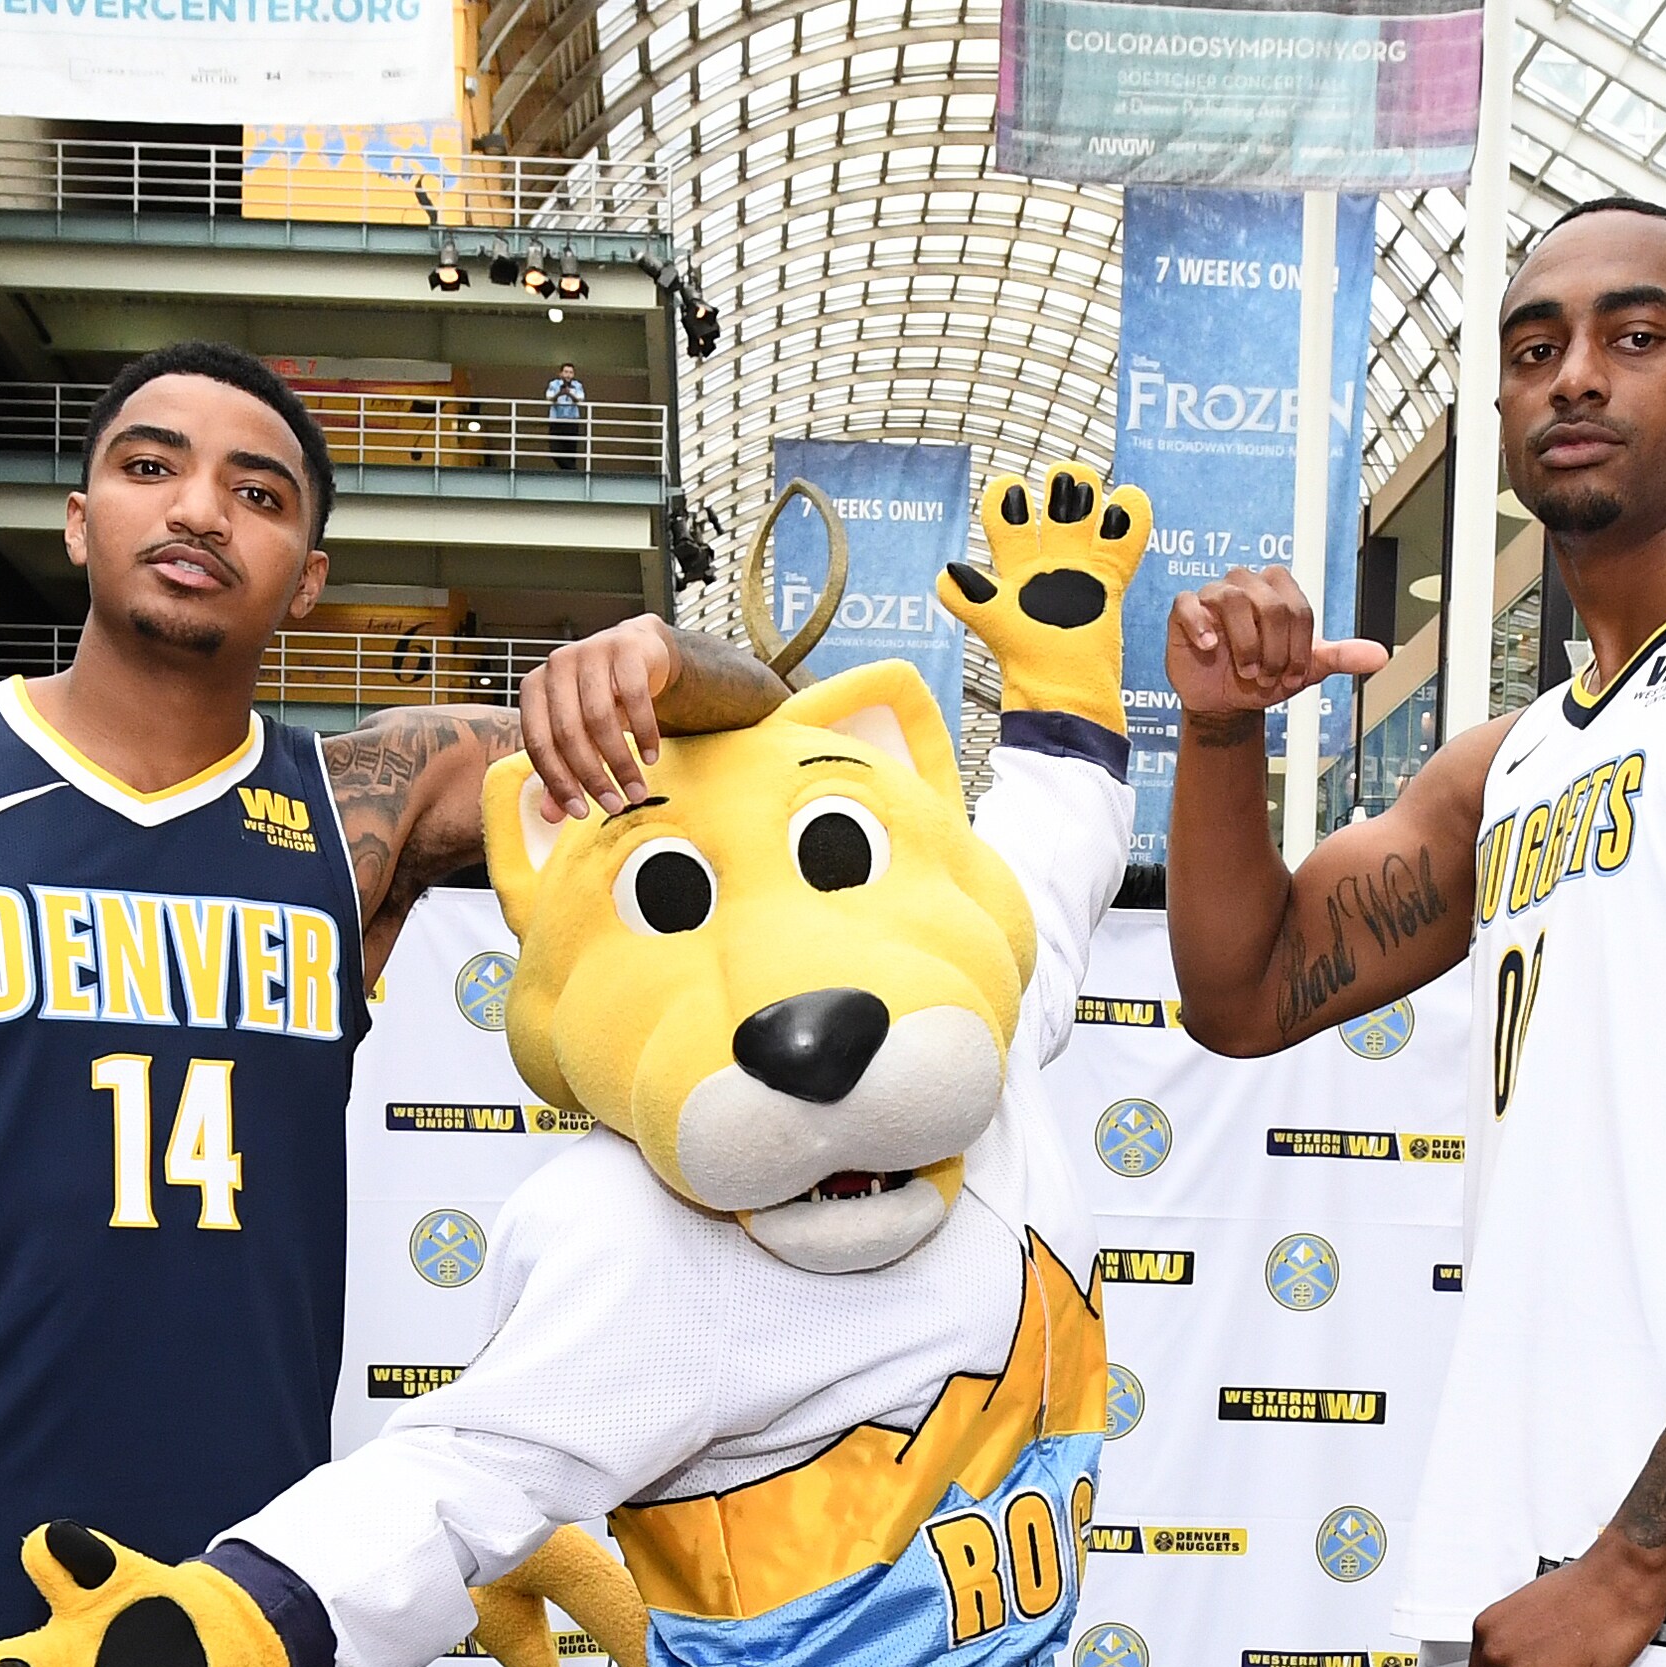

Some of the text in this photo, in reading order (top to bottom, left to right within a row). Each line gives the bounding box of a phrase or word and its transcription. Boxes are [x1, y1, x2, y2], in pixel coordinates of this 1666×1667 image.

[1065, 30, 1406, 62] COLORADOSYMPHONY.ORG
[1156, 256, 1170, 283] 7
[1178, 258, 1261, 288] WEEKS
[833, 498, 883, 520] EEKS
[889, 500, 944, 522] ONLY!
[1145, 530, 1194, 555] AUG
[1205, 531, 1231, 556] 17
[1259, 534, 1294, 560] OC
[1167, 560, 1220, 577] BUELL
[391, 620, 436, 684] 6
[237, 786, 310, 831] WU
[243, 819, 314, 843] WESTERN
[267, 832, 316, 854] UNION
[1112, 1002, 1154, 1025] WU
[393, 1107, 515, 1130] WESTERN WU
[415, 1118, 465, 1129] UNION
[92, 1053, 242, 1230] 14
[1273, 1132, 1389, 1157] WESTERN WU
[1293, 1144, 1341, 1155] UNION
[1130, 1252, 1185, 1281] WU
[1224, 1390, 1376, 1421] WESTERN WU
[1252, 1403, 1317, 1419] UNION
[1092, 1529, 1133, 1551] WU
[1176, 1532, 1230, 1541] DENVER
[1176, 1542, 1240, 1552] NUGGETS
[1248, 1653, 1318, 1666] WESTERN
